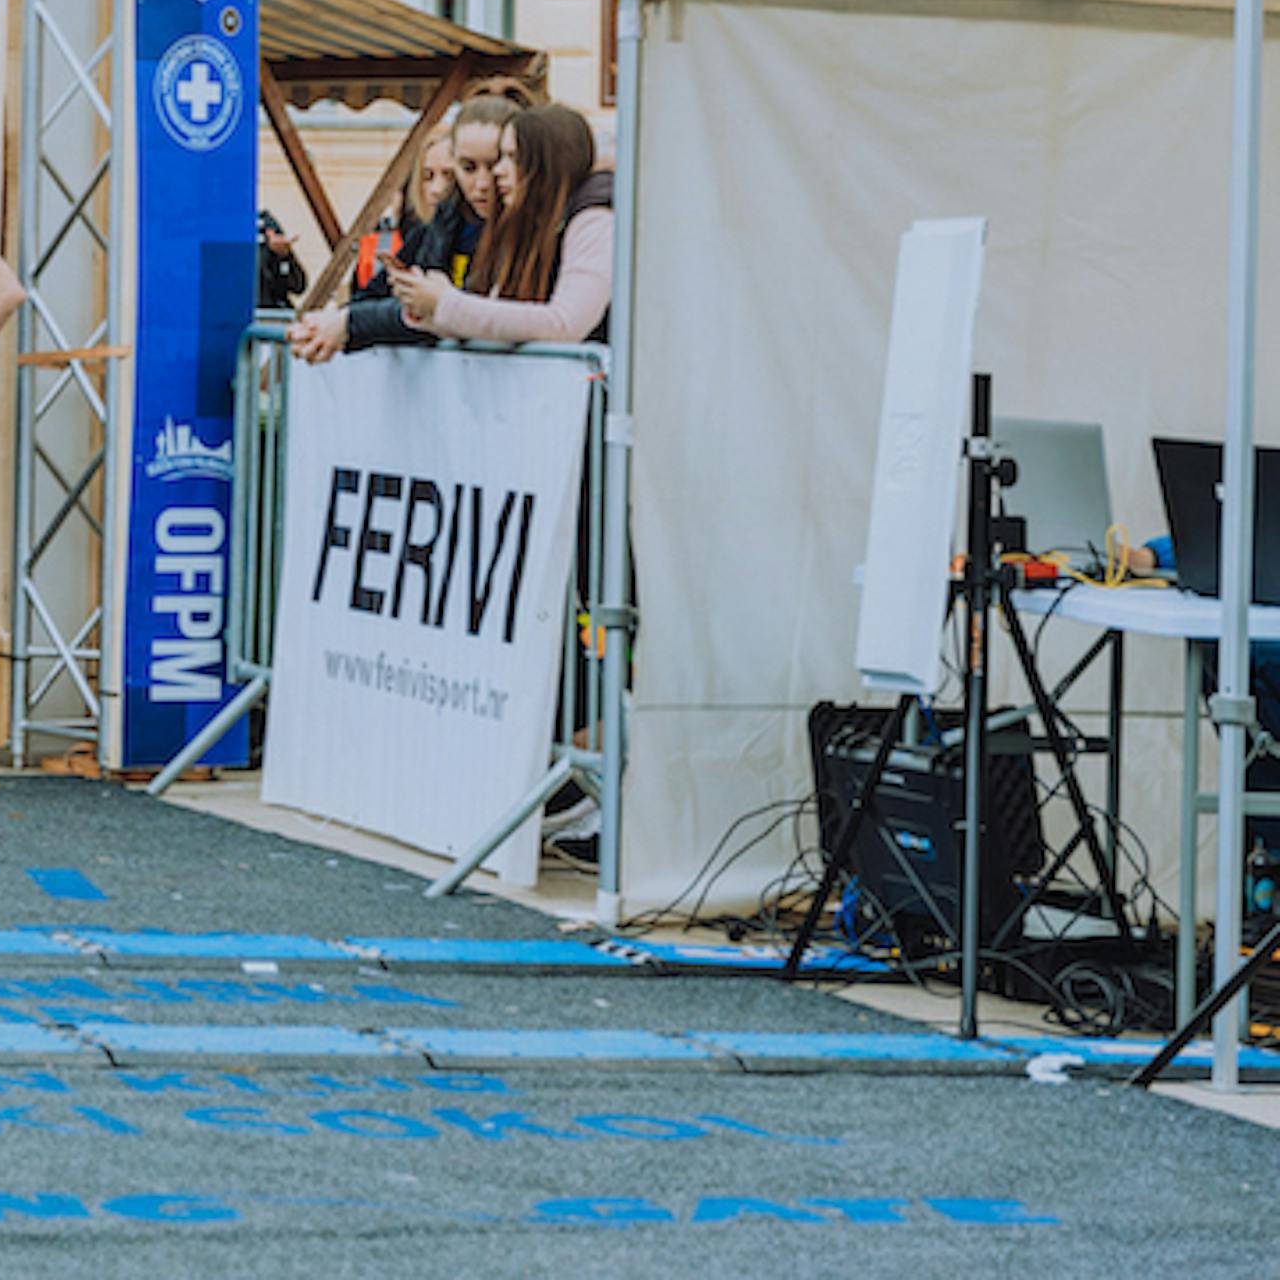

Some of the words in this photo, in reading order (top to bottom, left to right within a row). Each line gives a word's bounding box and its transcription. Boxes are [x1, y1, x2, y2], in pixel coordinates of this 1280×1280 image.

[149, 506, 225, 702] OFPM
[311, 465, 536, 644] FERIVI
[185, 1105, 847, 1146] SOKOL
